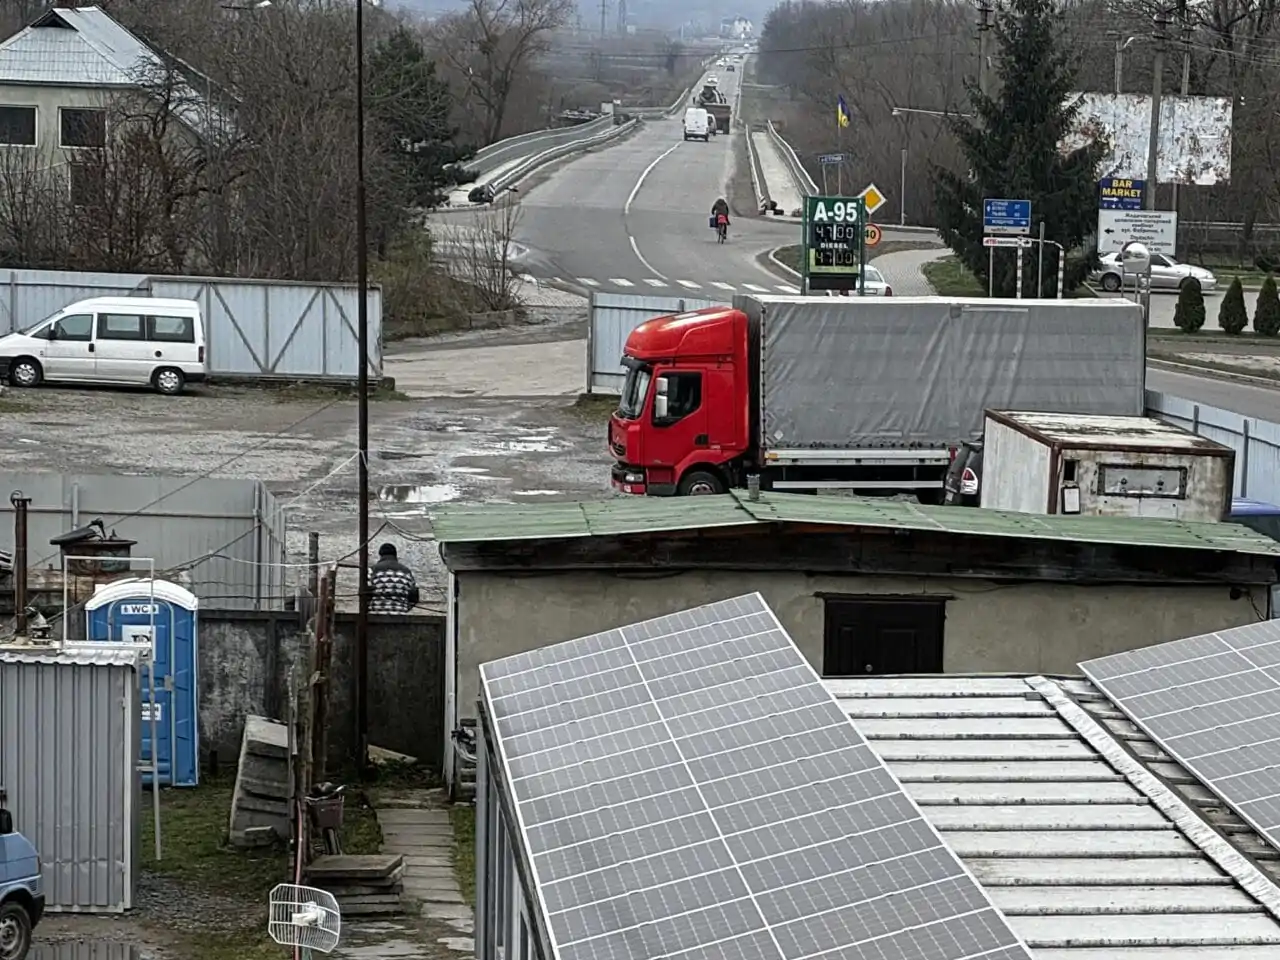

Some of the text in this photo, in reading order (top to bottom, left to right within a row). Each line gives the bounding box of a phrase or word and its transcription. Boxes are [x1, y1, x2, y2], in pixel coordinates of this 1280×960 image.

[1112, 180, 1132, 188] BAR
[1102, 188, 1141, 197] MARKET
[814, 202, 857, 222] A-95
[131, 605, 149, 613] WC
